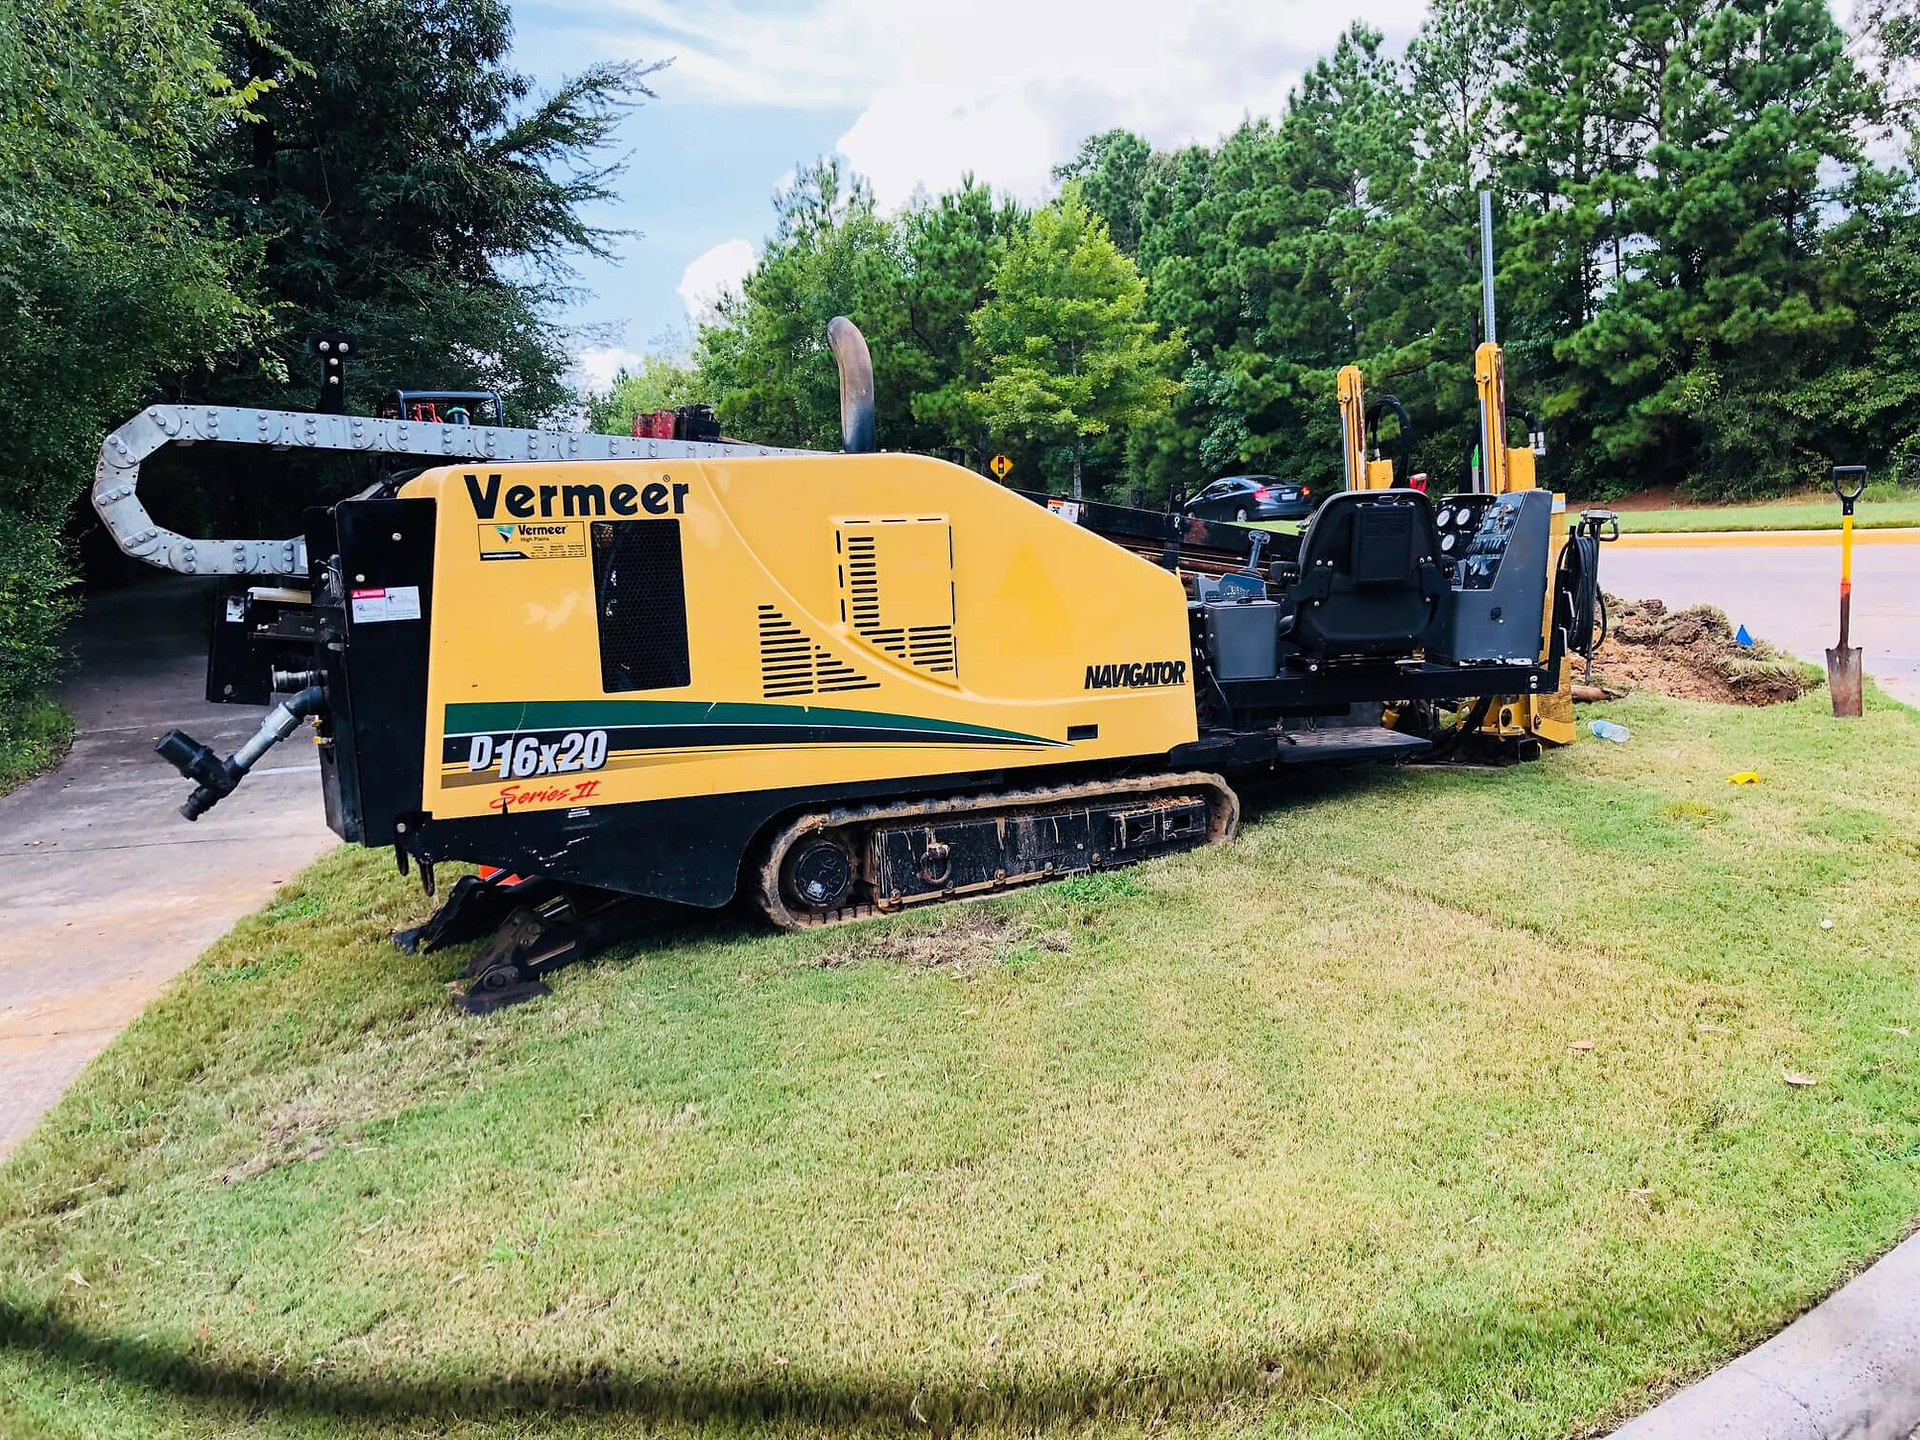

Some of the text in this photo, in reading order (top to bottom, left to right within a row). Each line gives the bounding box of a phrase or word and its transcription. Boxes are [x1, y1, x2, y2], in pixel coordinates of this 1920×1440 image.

[463, 474, 689, 520] Vermeer
[518, 525, 567, 535] Vermeer
[1084, 661, 1186, 689] NAVIGATOR
[469, 730, 609, 779] D16x20
[489, 785, 573, 809] Series
